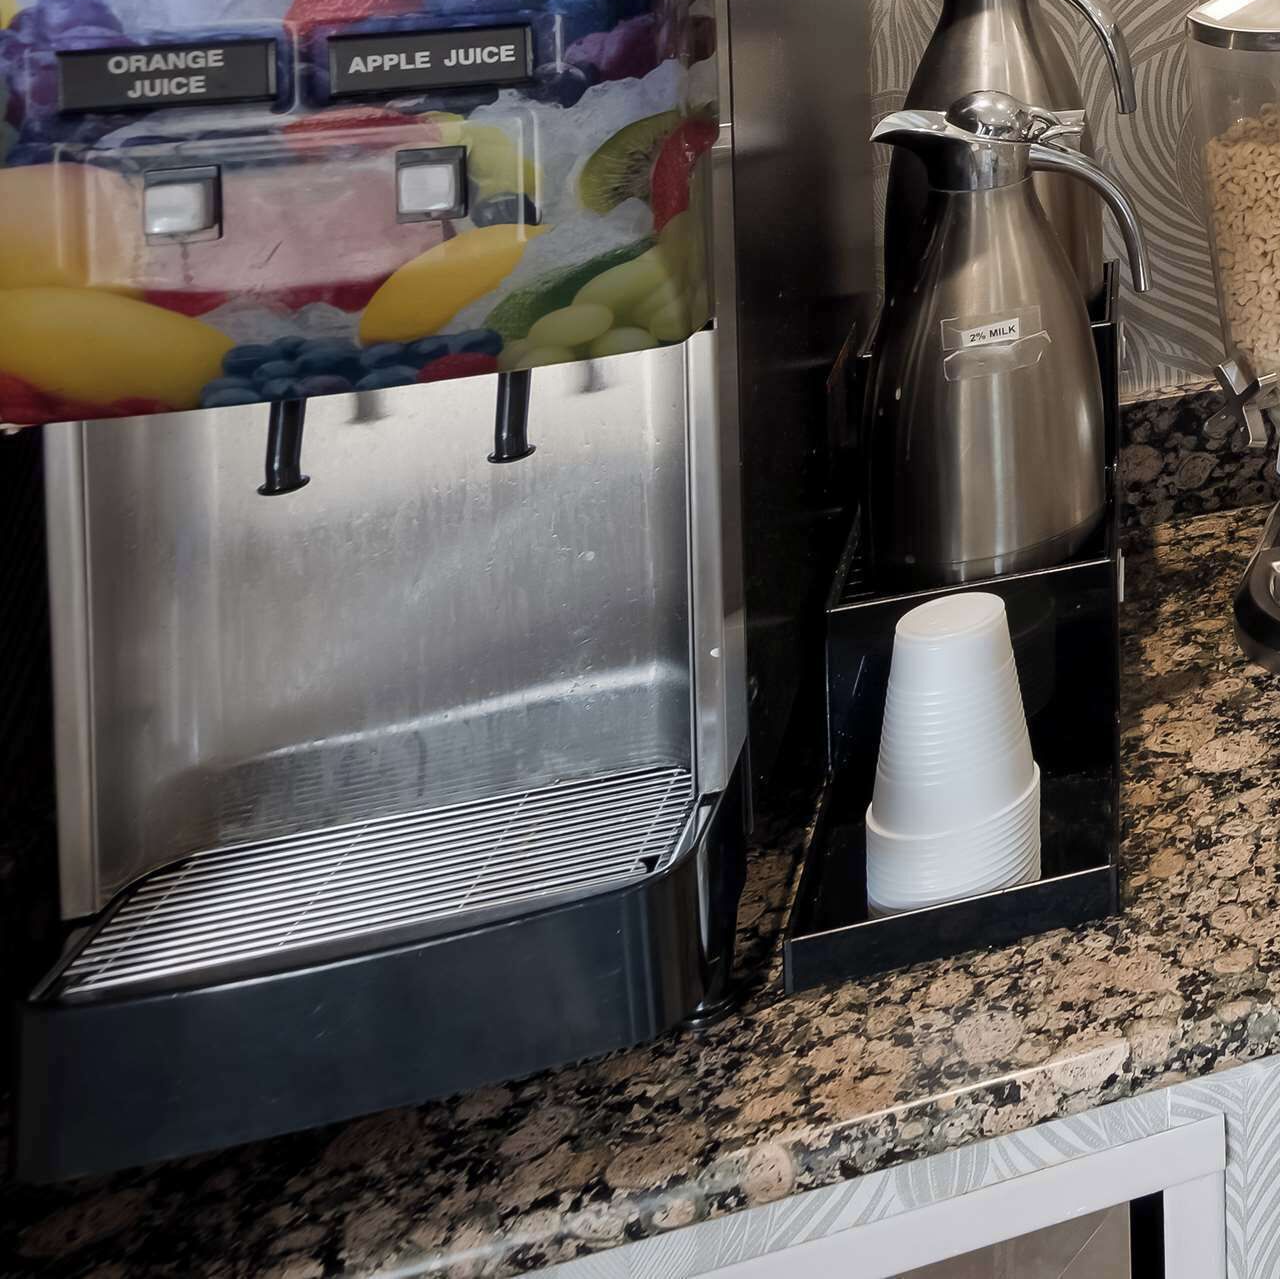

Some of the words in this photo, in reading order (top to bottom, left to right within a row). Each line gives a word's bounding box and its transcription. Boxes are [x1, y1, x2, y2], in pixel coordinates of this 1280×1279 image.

[107, 49, 225, 75] ORANGE
[348, 51, 432, 75] APPLE
[443, 44, 516, 67] JUICE
[127, 76, 207, 99] JUICE
[969, 331, 986, 342] 2%
[989, 324, 1016, 338] MILK
